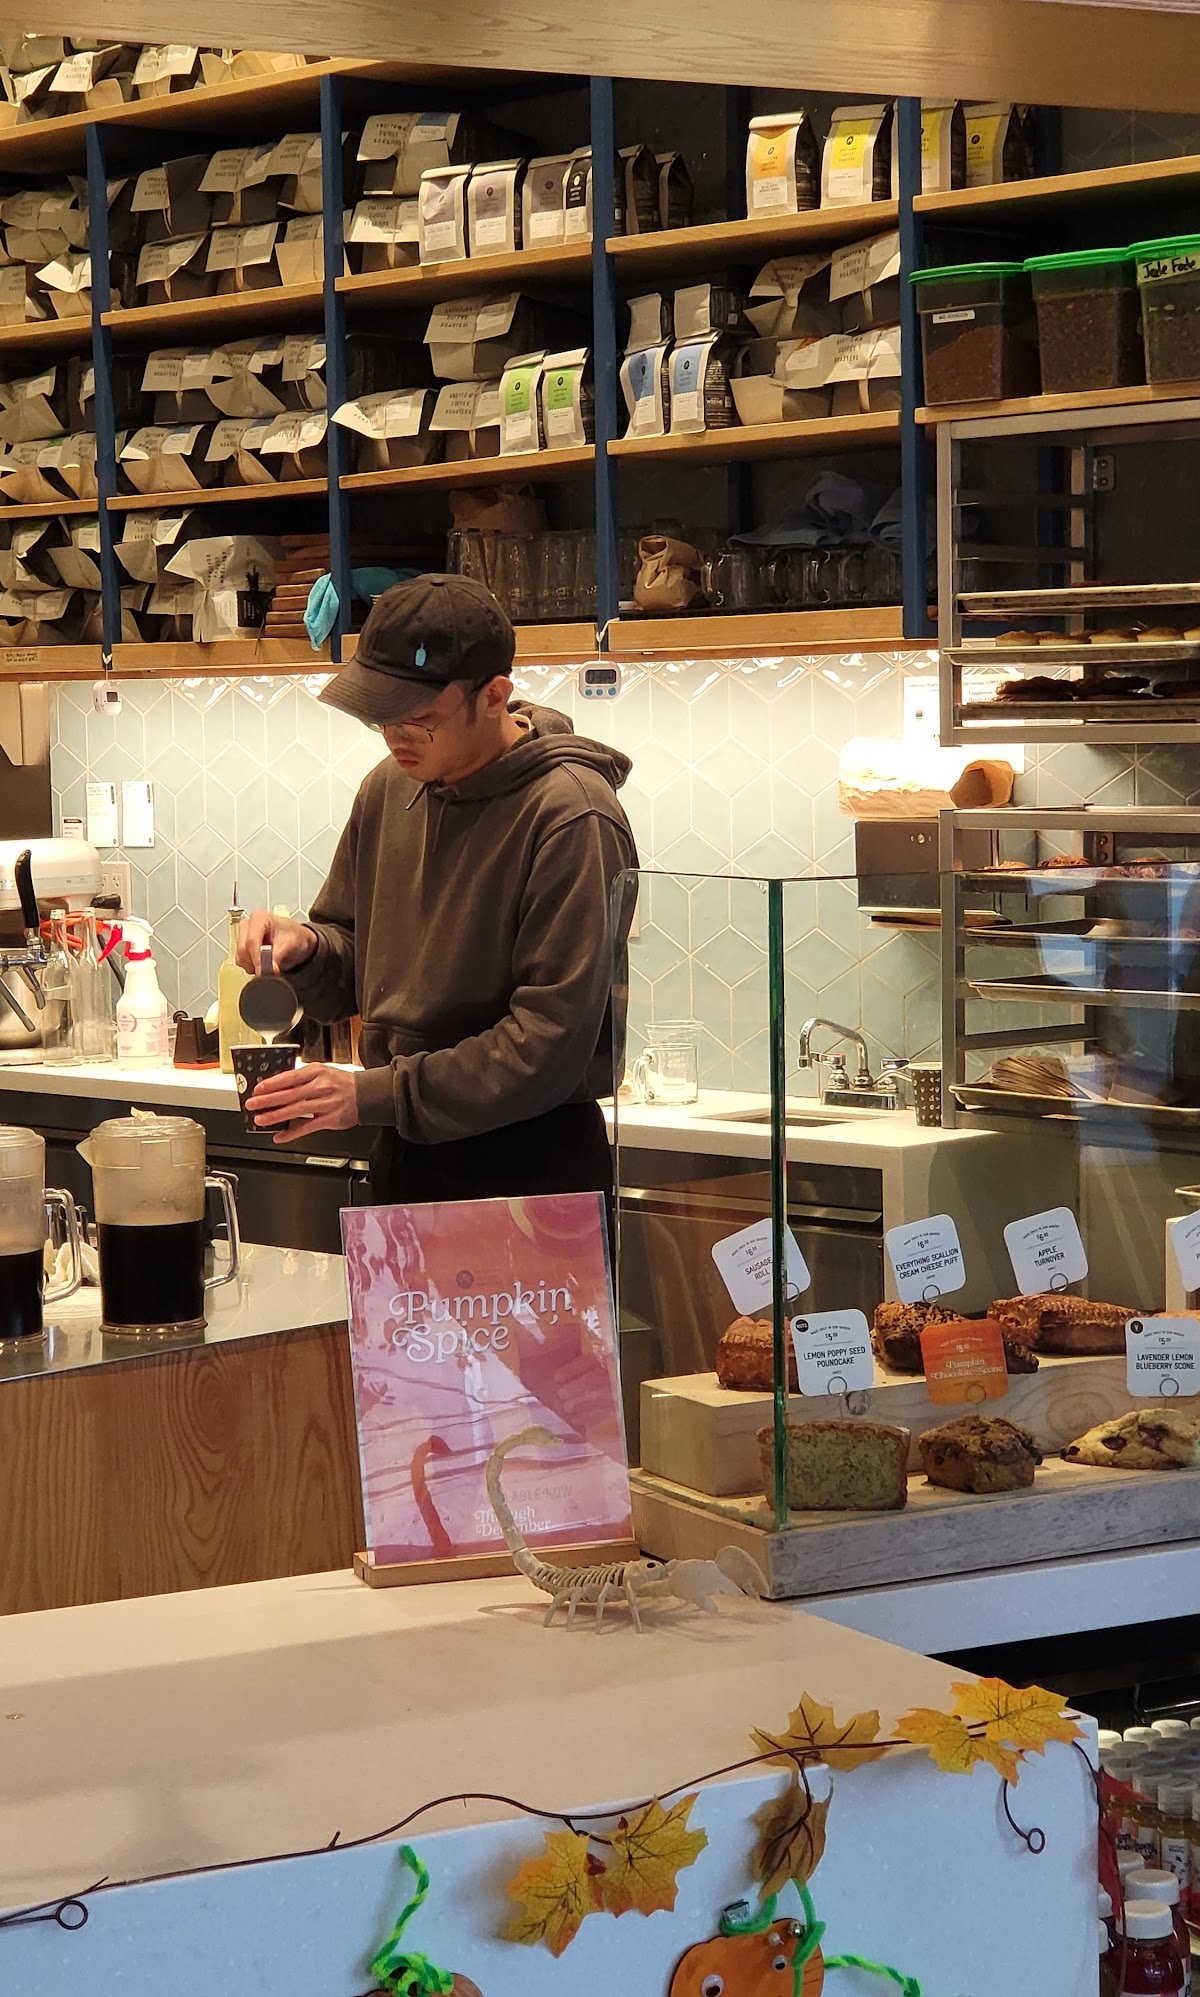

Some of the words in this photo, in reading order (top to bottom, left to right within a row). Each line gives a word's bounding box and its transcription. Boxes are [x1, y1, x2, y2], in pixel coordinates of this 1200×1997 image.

[1172, 256, 1196, 272] Fade
[895, 1255, 931, 1272] EVERYTHING
[931, 1247, 959, 1262] SCALLION
[1038, 1245, 1058, 1258] APPLE
[744, 1256, 774, 1275] SAUSAGE
[899, 1266, 920, 1279] CREAM
[920, 1261, 944, 1273] CHEESE
[944, 1255, 959, 1267] PUFF
[1034, 1252, 1066, 1268] TURNOVER
[754, 1269, 771, 1280] ROLL
[388, 1280, 573, 1325] Pumpkin
[392, 1320, 511, 1364] Spice
[803, 1350, 826, 1361] LEMON
[827, 1348, 848, 1358] POPPY
[848, 1346, 866, 1355] SEED
[1137, 1353, 1170, 1361] LAVENDER
[1171, 1353, 1194, 1361] LEMON
[816, 1356, 855, 1368] POUNDCAKE
[945, 1358, 985, 1369] Pumpkin
[1135, 1362, 1173, 1370] BLUEBERRY
[1174, 1362, 1196, 1370] SCONE
[479, 1485, 541, 1505] AABLE
[474, 1505, 536, 1524] Thugh
[475, 1520, 552, 1537] Dember
